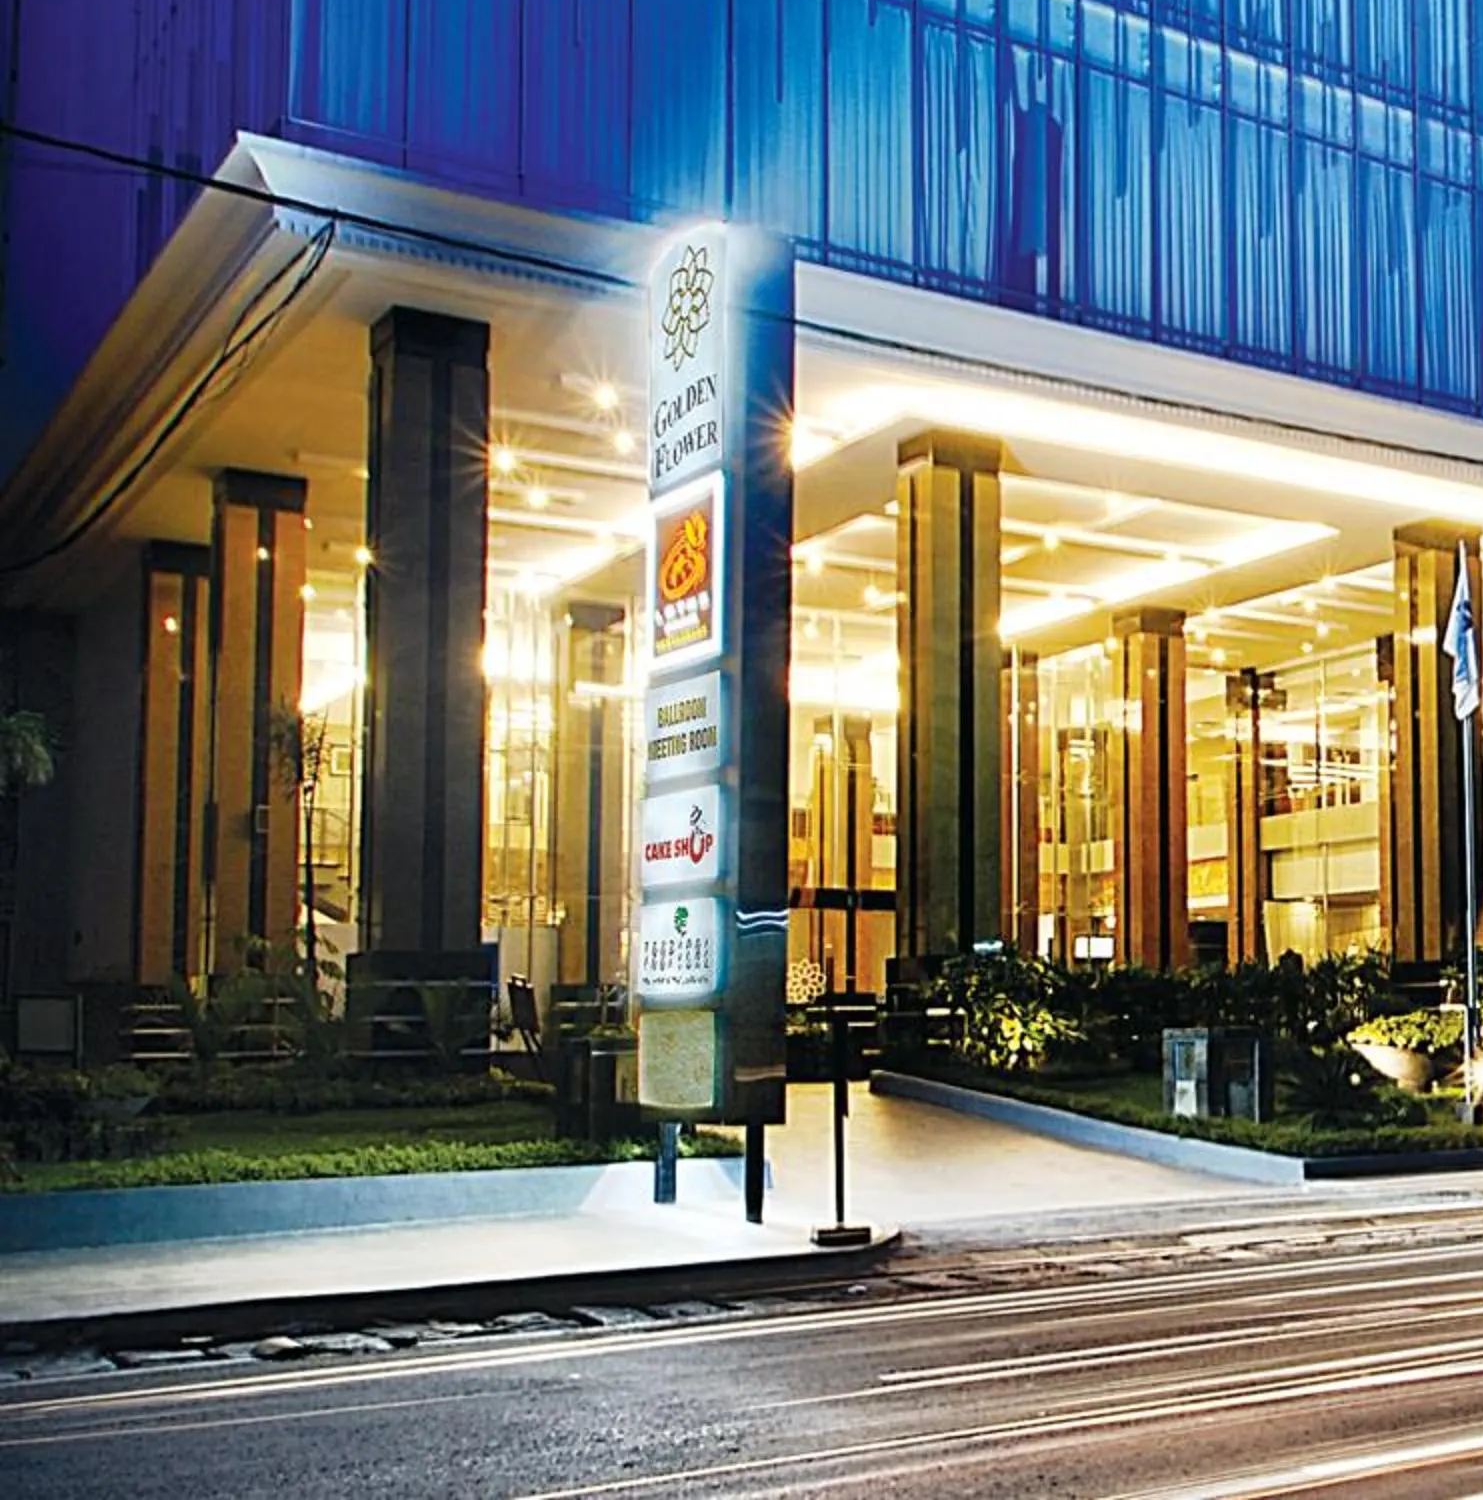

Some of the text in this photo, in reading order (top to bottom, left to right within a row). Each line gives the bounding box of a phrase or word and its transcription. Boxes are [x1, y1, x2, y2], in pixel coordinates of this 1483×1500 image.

[654, 373, 717, 438] GOLDEN
[655, 420, 718, 478] FLOWER
[658, 695, 706, 728] BALLROOM
[647, 725, 717, 761] MEETING ROOM
[645, 840, 672, 862] CAKE
